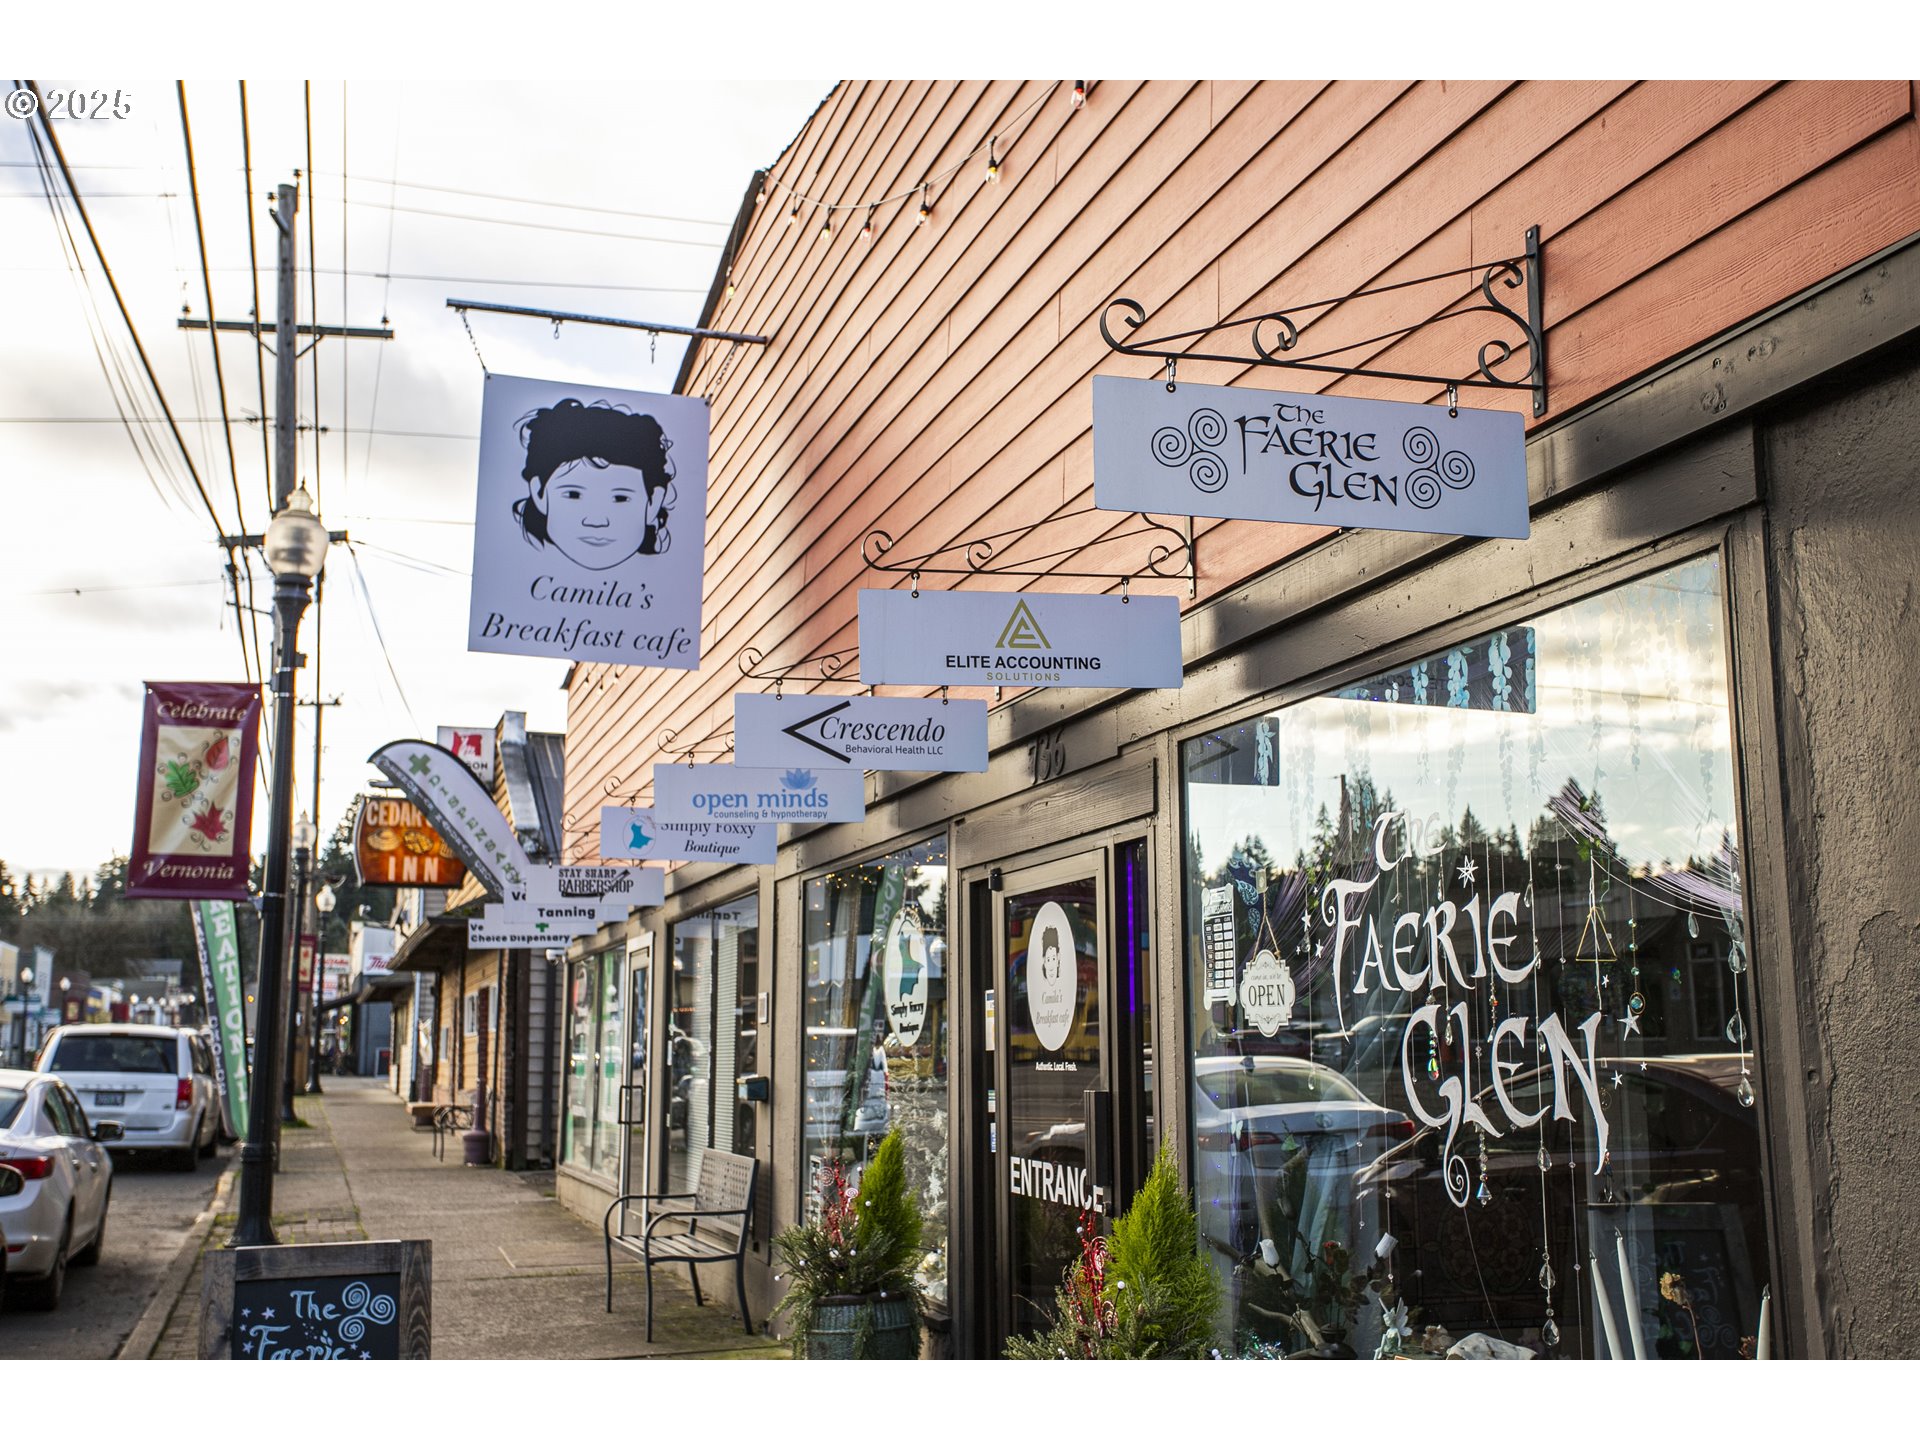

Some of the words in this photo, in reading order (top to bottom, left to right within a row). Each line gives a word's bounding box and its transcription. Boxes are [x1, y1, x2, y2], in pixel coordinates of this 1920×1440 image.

[530, 575, 653, 610] Camila's
[480, 612, 625, 652] Breakfast
[632, 627, 691, 660] cafe
[945, 655, 991, 669] ELITE
[994, 656, 1101, 670] ACCOUNTING
[986, 672, 1061, 682] SOLUTIONS
[156, 701, 248, 722] Celebrate
[819, 716, 946, 742] Crescendo
[845, 744, 893, 755] Behavioral
[895, 745, 925, 755] Health
[927, 746, 944, 756] LLC
[691, 793, 748, 815] open
[757, 787, 829, 809] minds
[366, 801, 423, 828] CEDAR
[713, 809, 760, 820] counseling
[761, 809, 768, 818] &
[770, 809, 828, 820] hypnotherapy
[683, 840, 740, 857] Boutique
[142, 860, 235, 880] Vernonia
[388, 856, 439, 882] INN
[558, 869, 581, 878] STAY
[585, 869, 617, 879] SHARP
[537, 907, 595, 919] Tanning
[470, 934, 508, 944] Choice
[510, 933, 571, 945] Dispensary
[1248, 984, 1285, 1007] OPEN
[1010, 1156, 1104, 1213] ENTRANCE
[289, 1290, 341, 1321] The
